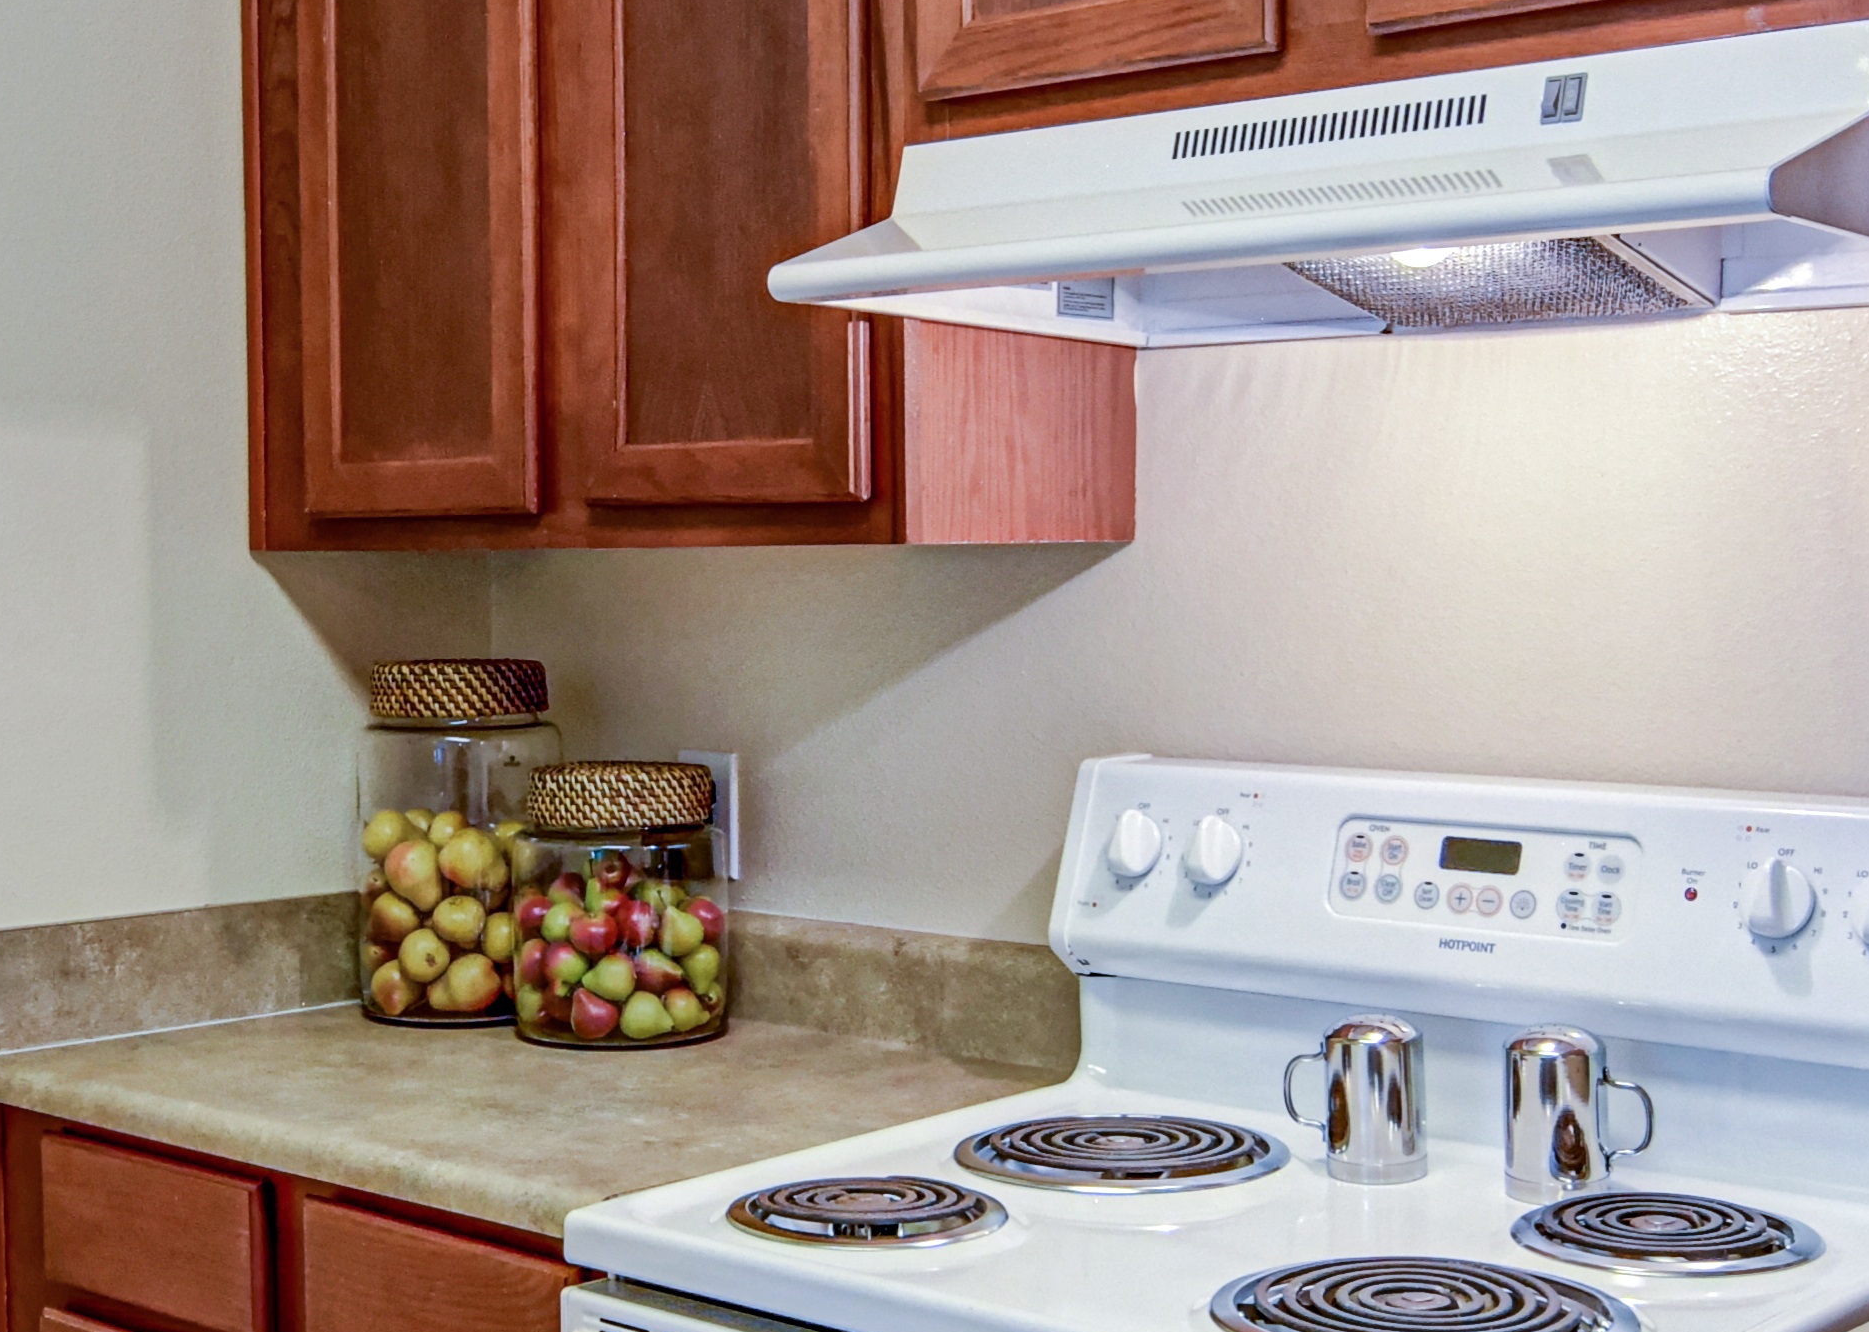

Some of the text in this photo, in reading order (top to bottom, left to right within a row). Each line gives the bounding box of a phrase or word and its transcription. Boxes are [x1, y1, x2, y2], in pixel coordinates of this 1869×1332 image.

[1369, 824, 1390, 832] OVEN
[1777, 848, 1795, 857] OFF
[1747, 861, 1758, 870] LO
[1681, 868, 1706, 877] Burner
[1814, 867, 1822, 875] HI
[1857, 870, 1869, 878] LO
[1686, 877, 1698, 885] On
[1438, 938, 1496, 954] HOTPOINT
